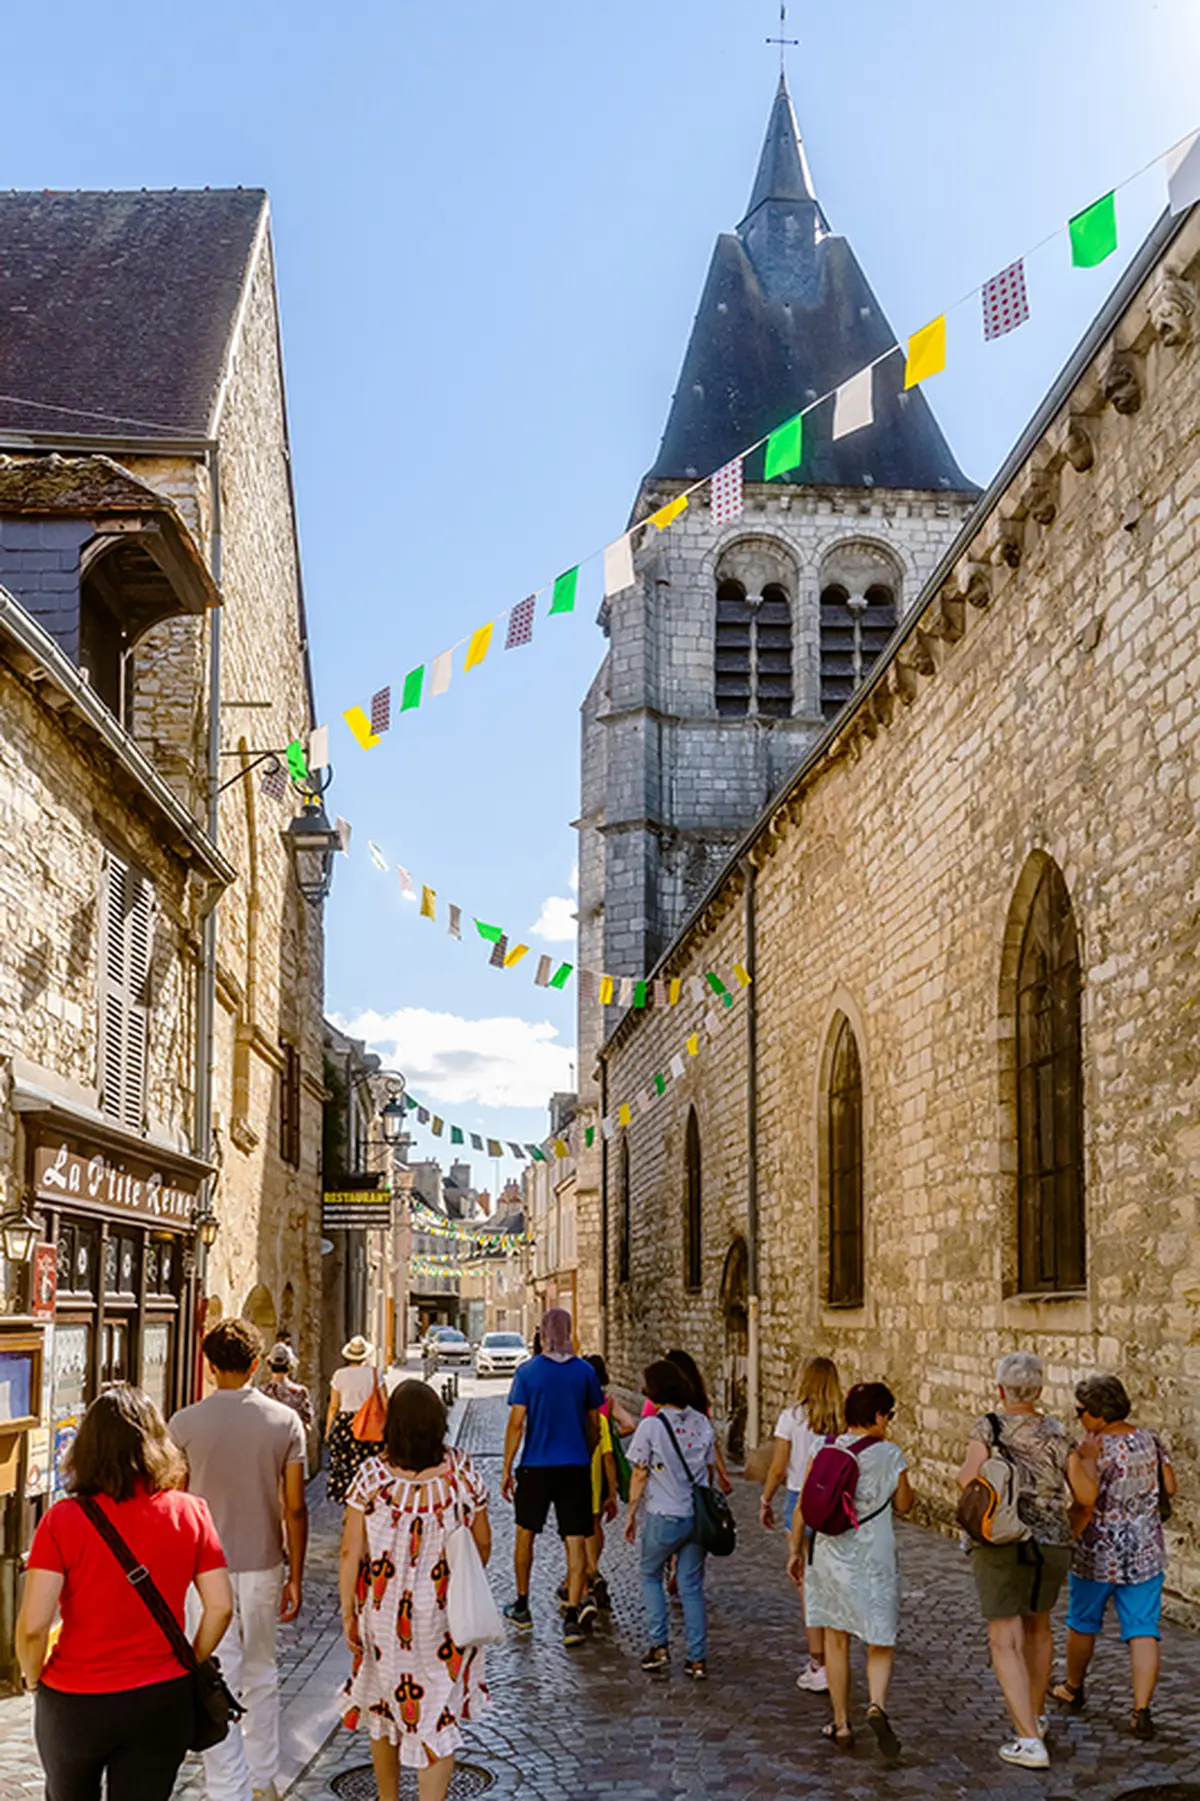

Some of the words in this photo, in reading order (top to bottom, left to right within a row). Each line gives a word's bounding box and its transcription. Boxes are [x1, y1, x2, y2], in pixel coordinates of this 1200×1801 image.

[43, 1143, 80, 1192] La
[146, 1172, 191, 1217] Reine
[323, 1192, 391, 1203] RESTAURANT
